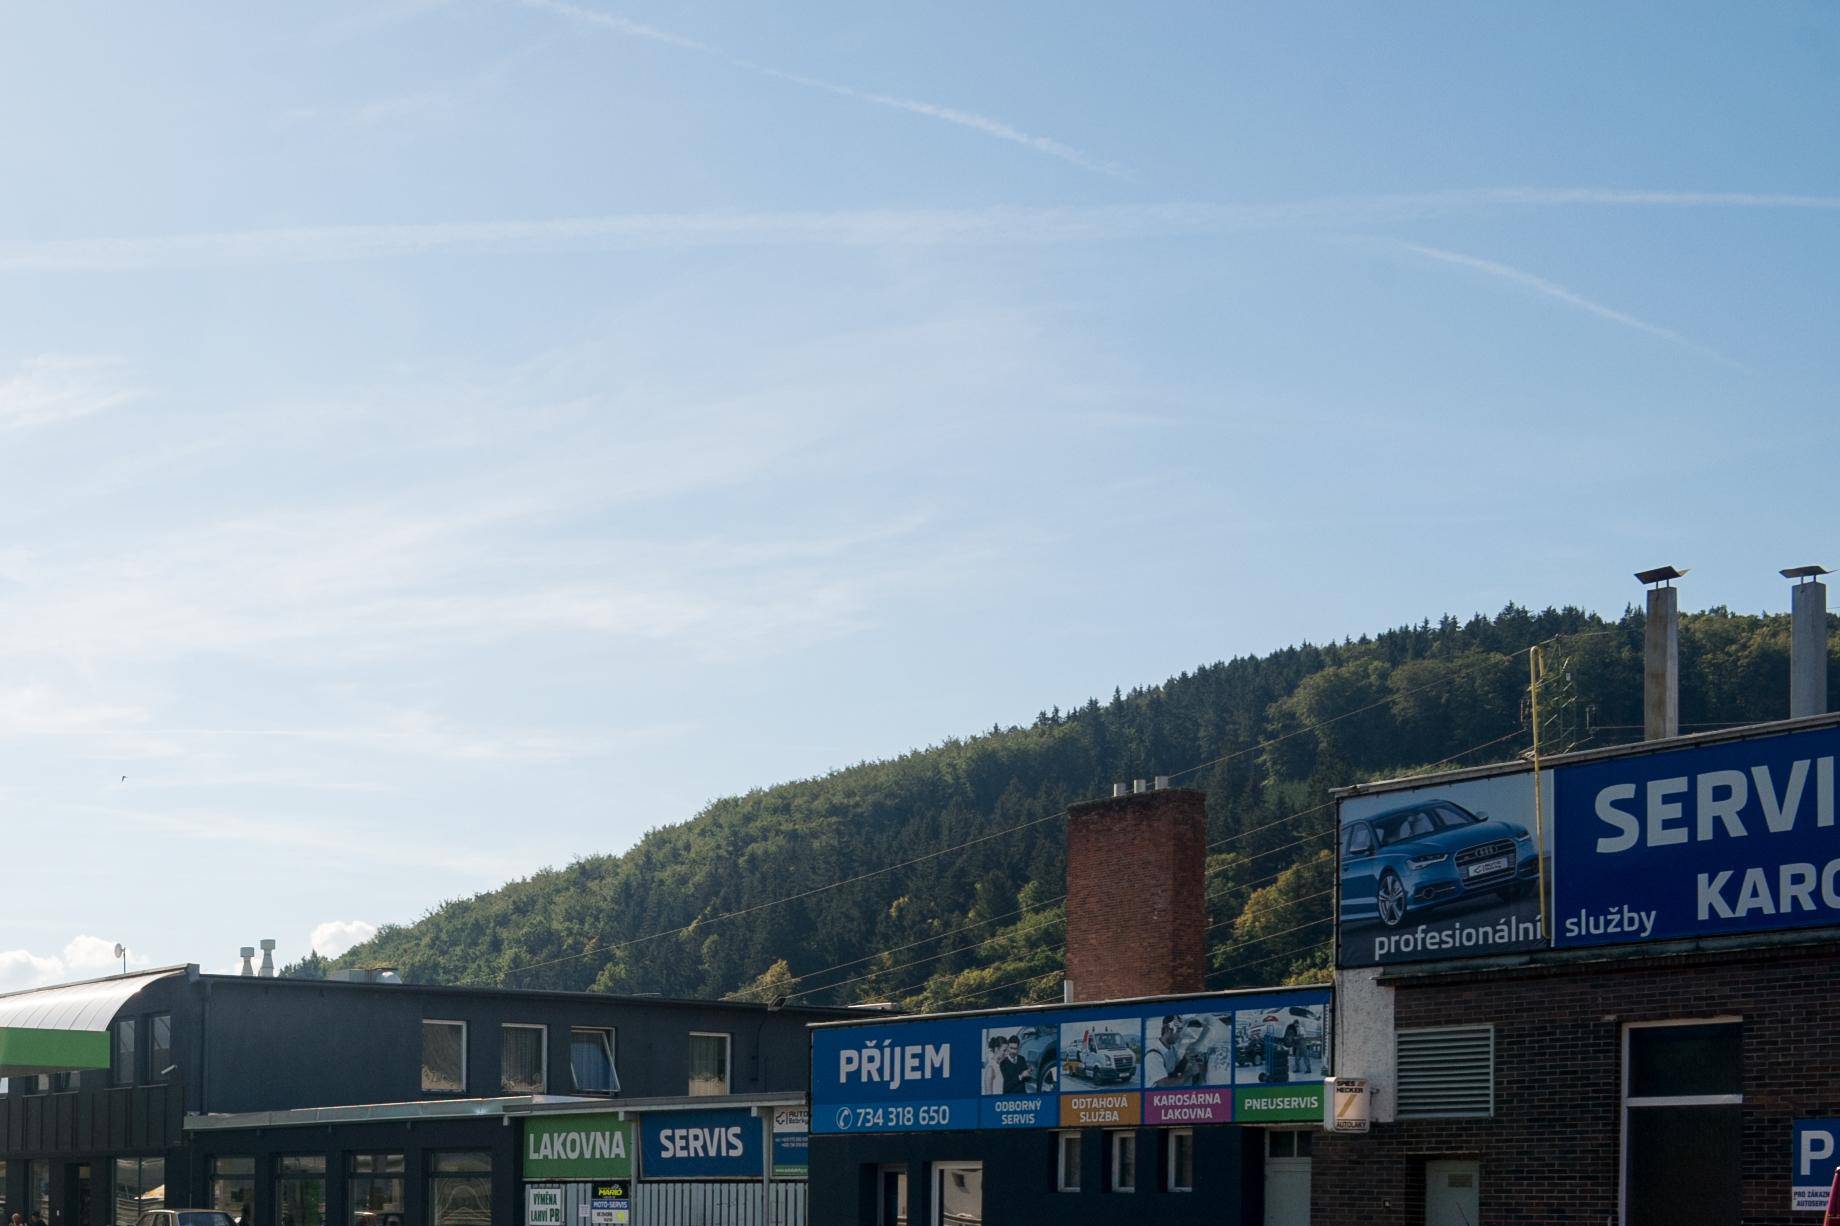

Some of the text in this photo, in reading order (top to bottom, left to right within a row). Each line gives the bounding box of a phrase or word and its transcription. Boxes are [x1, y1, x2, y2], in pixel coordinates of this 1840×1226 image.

[1595, 756, 1835, 853] SERVI
[1375, 904, 1657, 961] profesionální služby
[840, 1039, 951, 1090] PŘÍJEM
[995, 1097, 1042, 1112] ODBORNÝ
[1071, 1094, 1128, 1110] ODTAHOVÁ
[1153, 1091, 1222, 1107] KAROSÁRNA
[1244, 1096, 1319, 1111] PNEUSERVIS
[856, 1105, 950, 1127] 734 318 650
[1001, 1113, 1035, 1125] SERVIS
[1079, 1109, 1120, 1123] SLUŽBA
[1161, 1107, 1213, 1120] LAKOVNA
[529, 1131, 626, 1160] LAKOVNA
[659, 1126, 744, 1158] SERVIS
[1801, 1130, 1835, 1175] P
[533, 1191, 557, 1205] VÝMĚNA
[593, 1201, 628, 1209] MOTO-SERVIS
[531, 1208, 560, 1222] LAHVÍ PB
